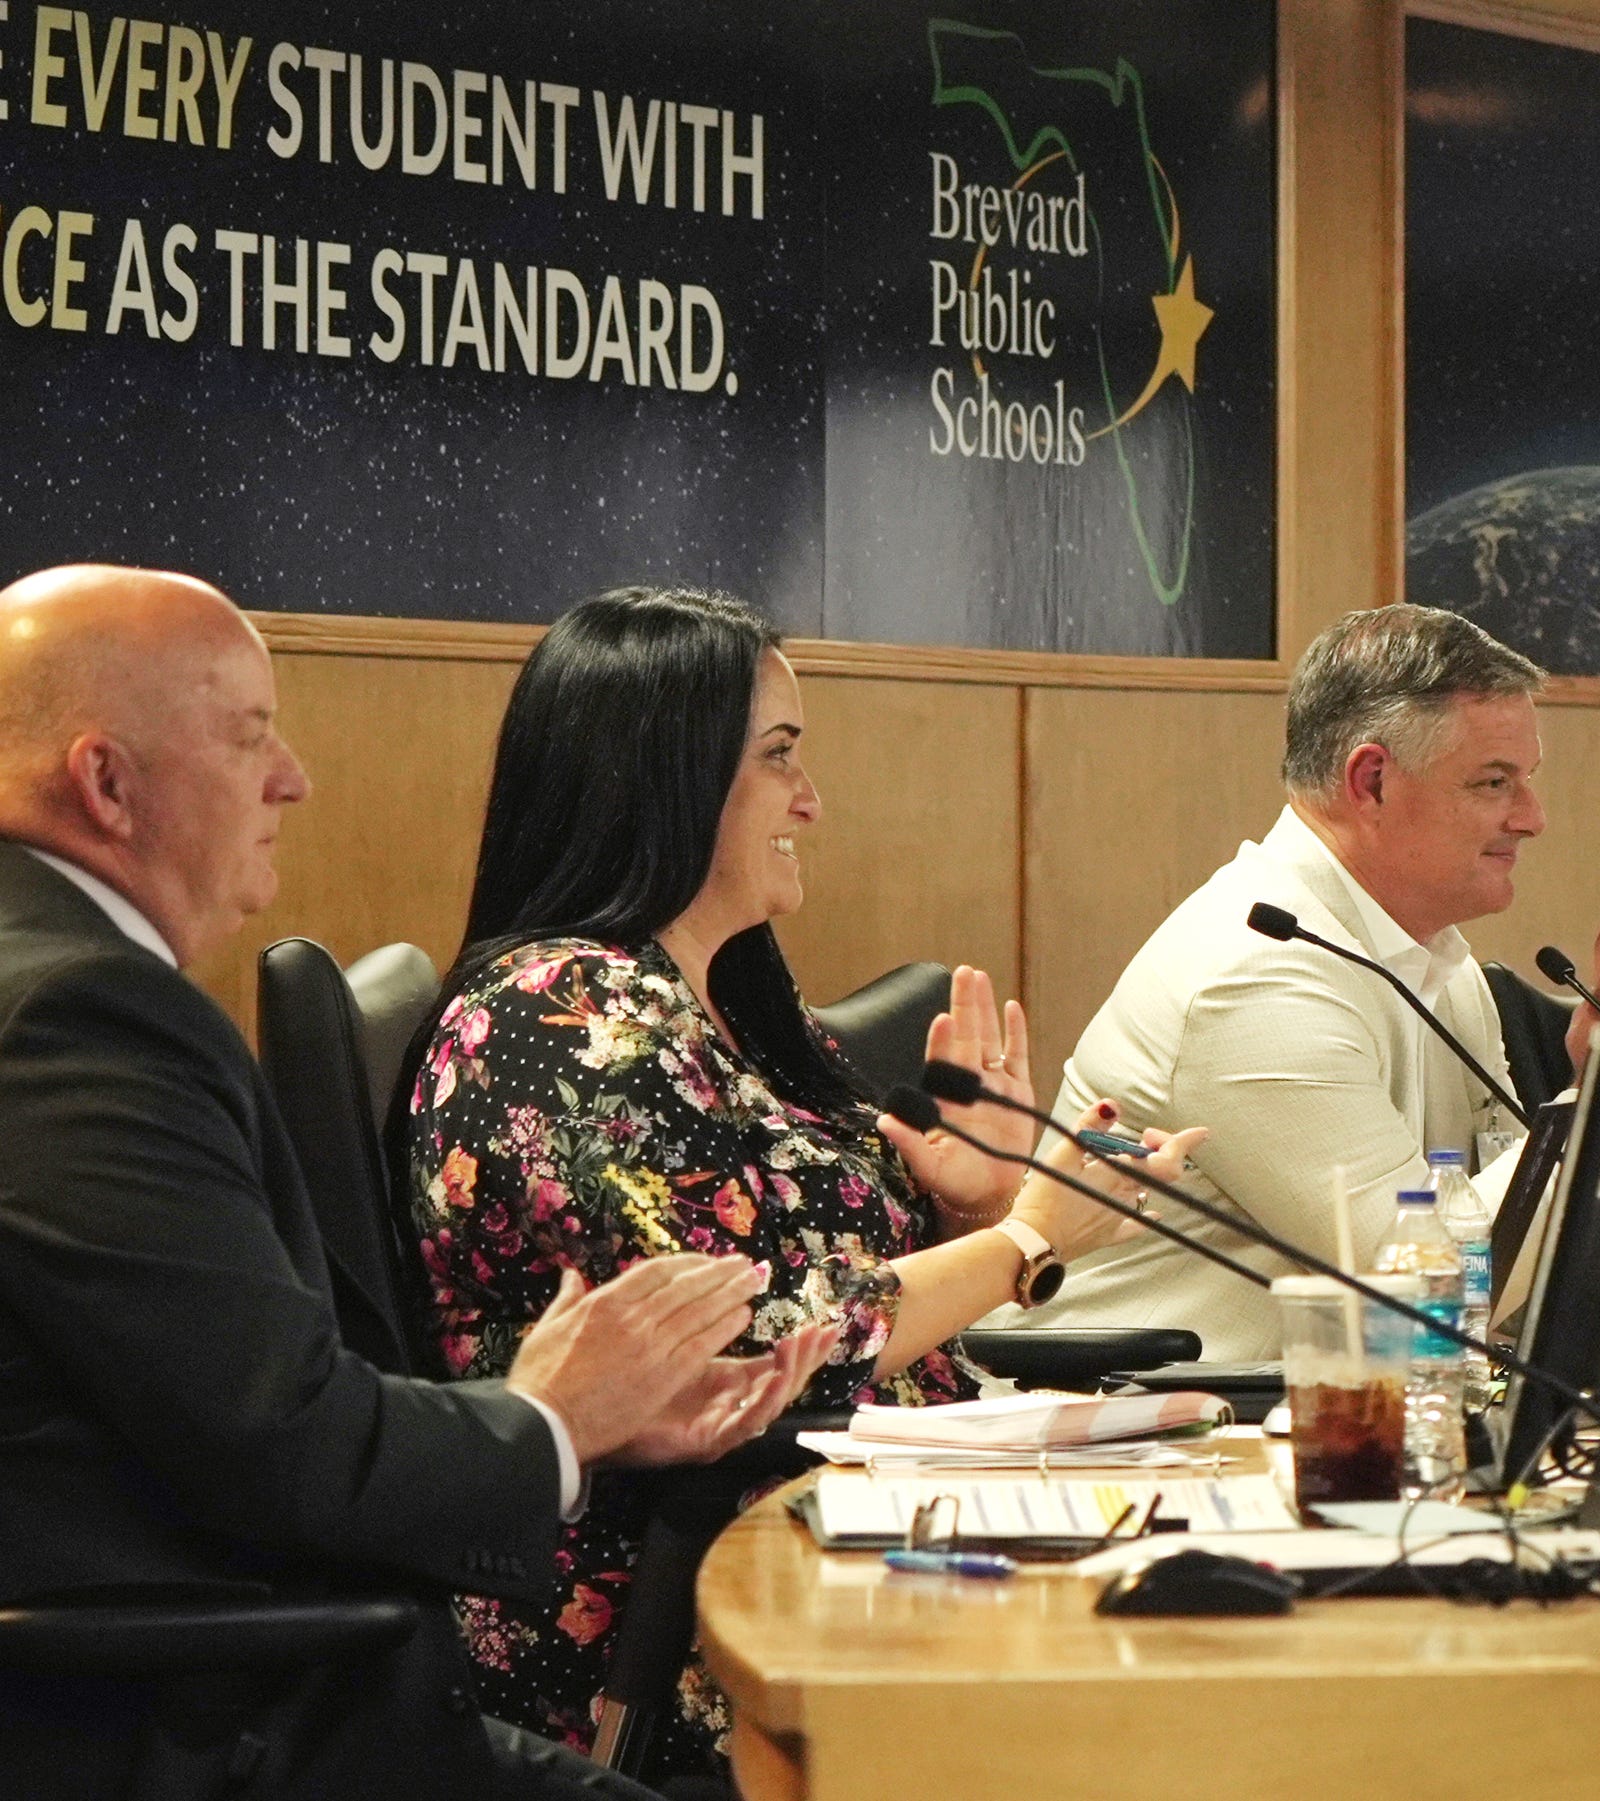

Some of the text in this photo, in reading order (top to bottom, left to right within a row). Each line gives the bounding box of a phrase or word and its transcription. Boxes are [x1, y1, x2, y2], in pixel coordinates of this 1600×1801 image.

[31, 5, 253, 150] EVERY
[267, 42, 579, 193] STUDENT
[593, 90, 764, 219] WITH
[929, 151, 1089, 257] Brevard
[2, 205, 738, 396] CE AS THE STANDARD.
[929, 260, 1056, 358] Public
[929, 366, 1086, 466] Schools
